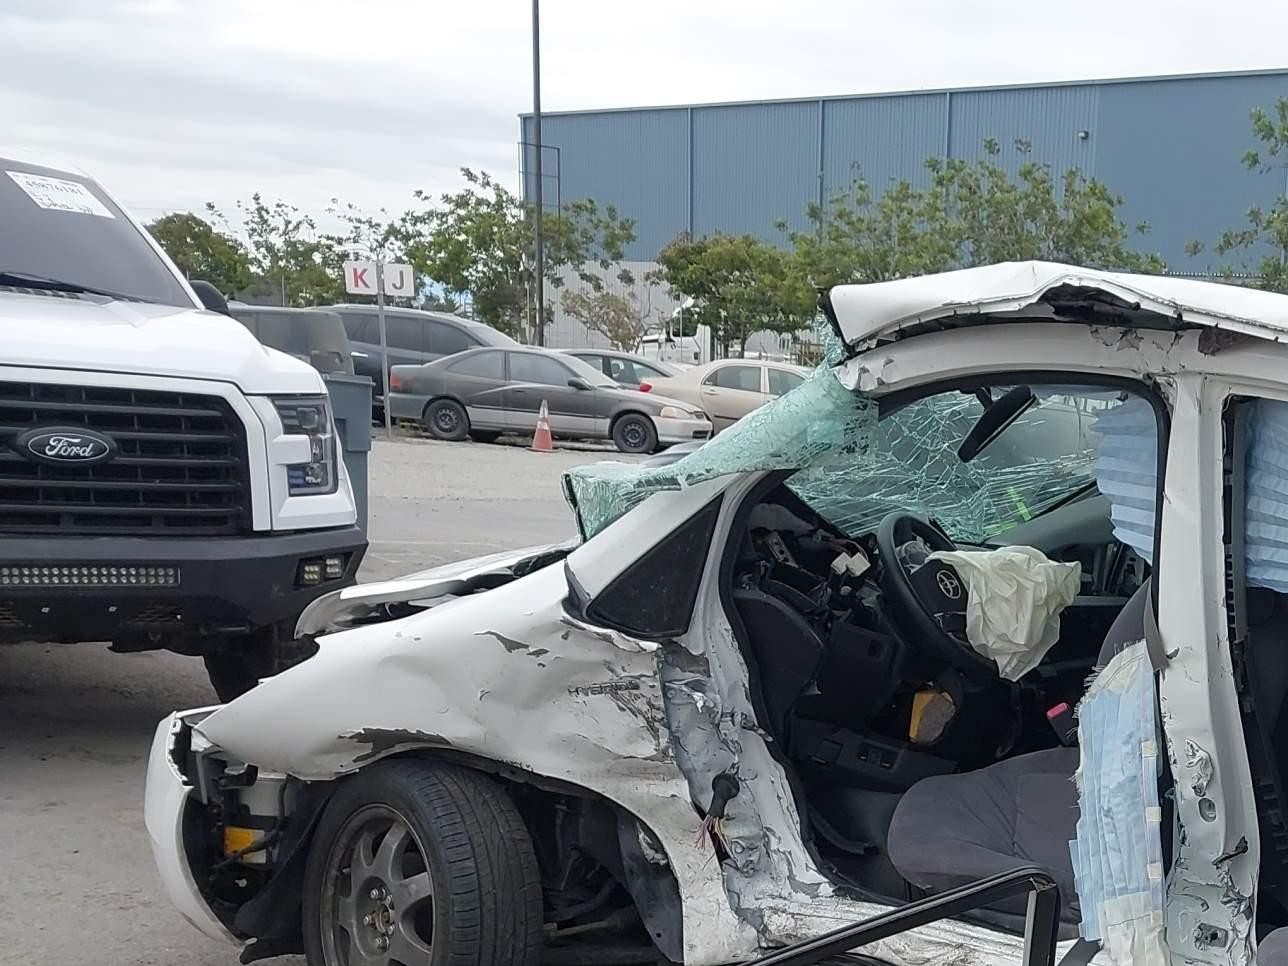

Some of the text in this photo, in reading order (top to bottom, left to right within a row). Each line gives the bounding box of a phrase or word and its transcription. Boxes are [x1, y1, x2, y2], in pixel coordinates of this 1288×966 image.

[353, 268, 370, 288] K
[392, 270, 404, 290] J
[45, 436, 94, 456] Ford
